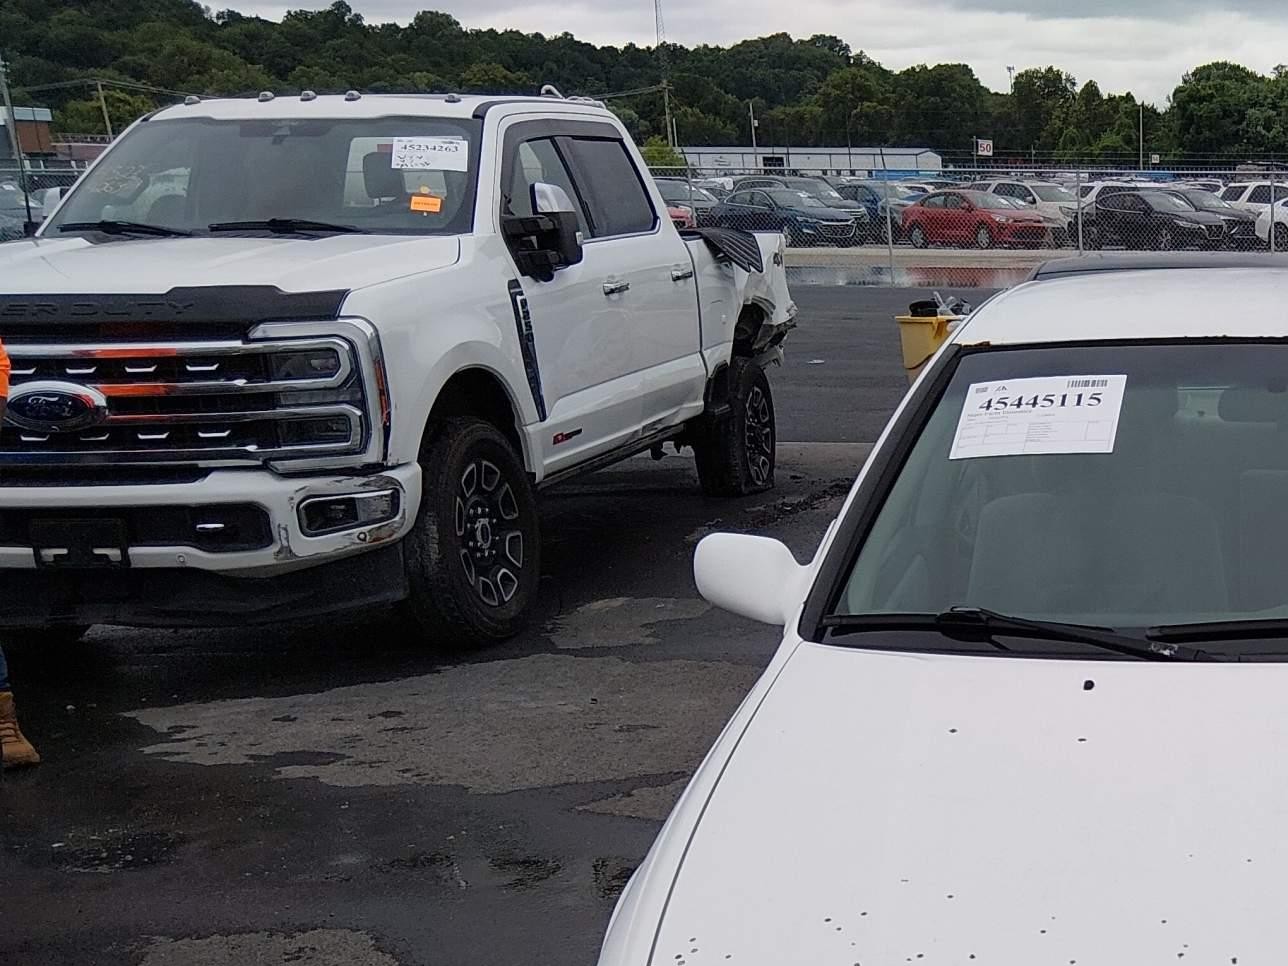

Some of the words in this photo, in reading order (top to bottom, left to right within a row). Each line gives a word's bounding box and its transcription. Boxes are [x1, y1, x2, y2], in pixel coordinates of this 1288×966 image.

[400, 144, 459, 153] 45234263
[979, 142, 992, 153] 50
[70, 302, 195, 317] DUTY
[978, 392, 1103, 411] 45445115
